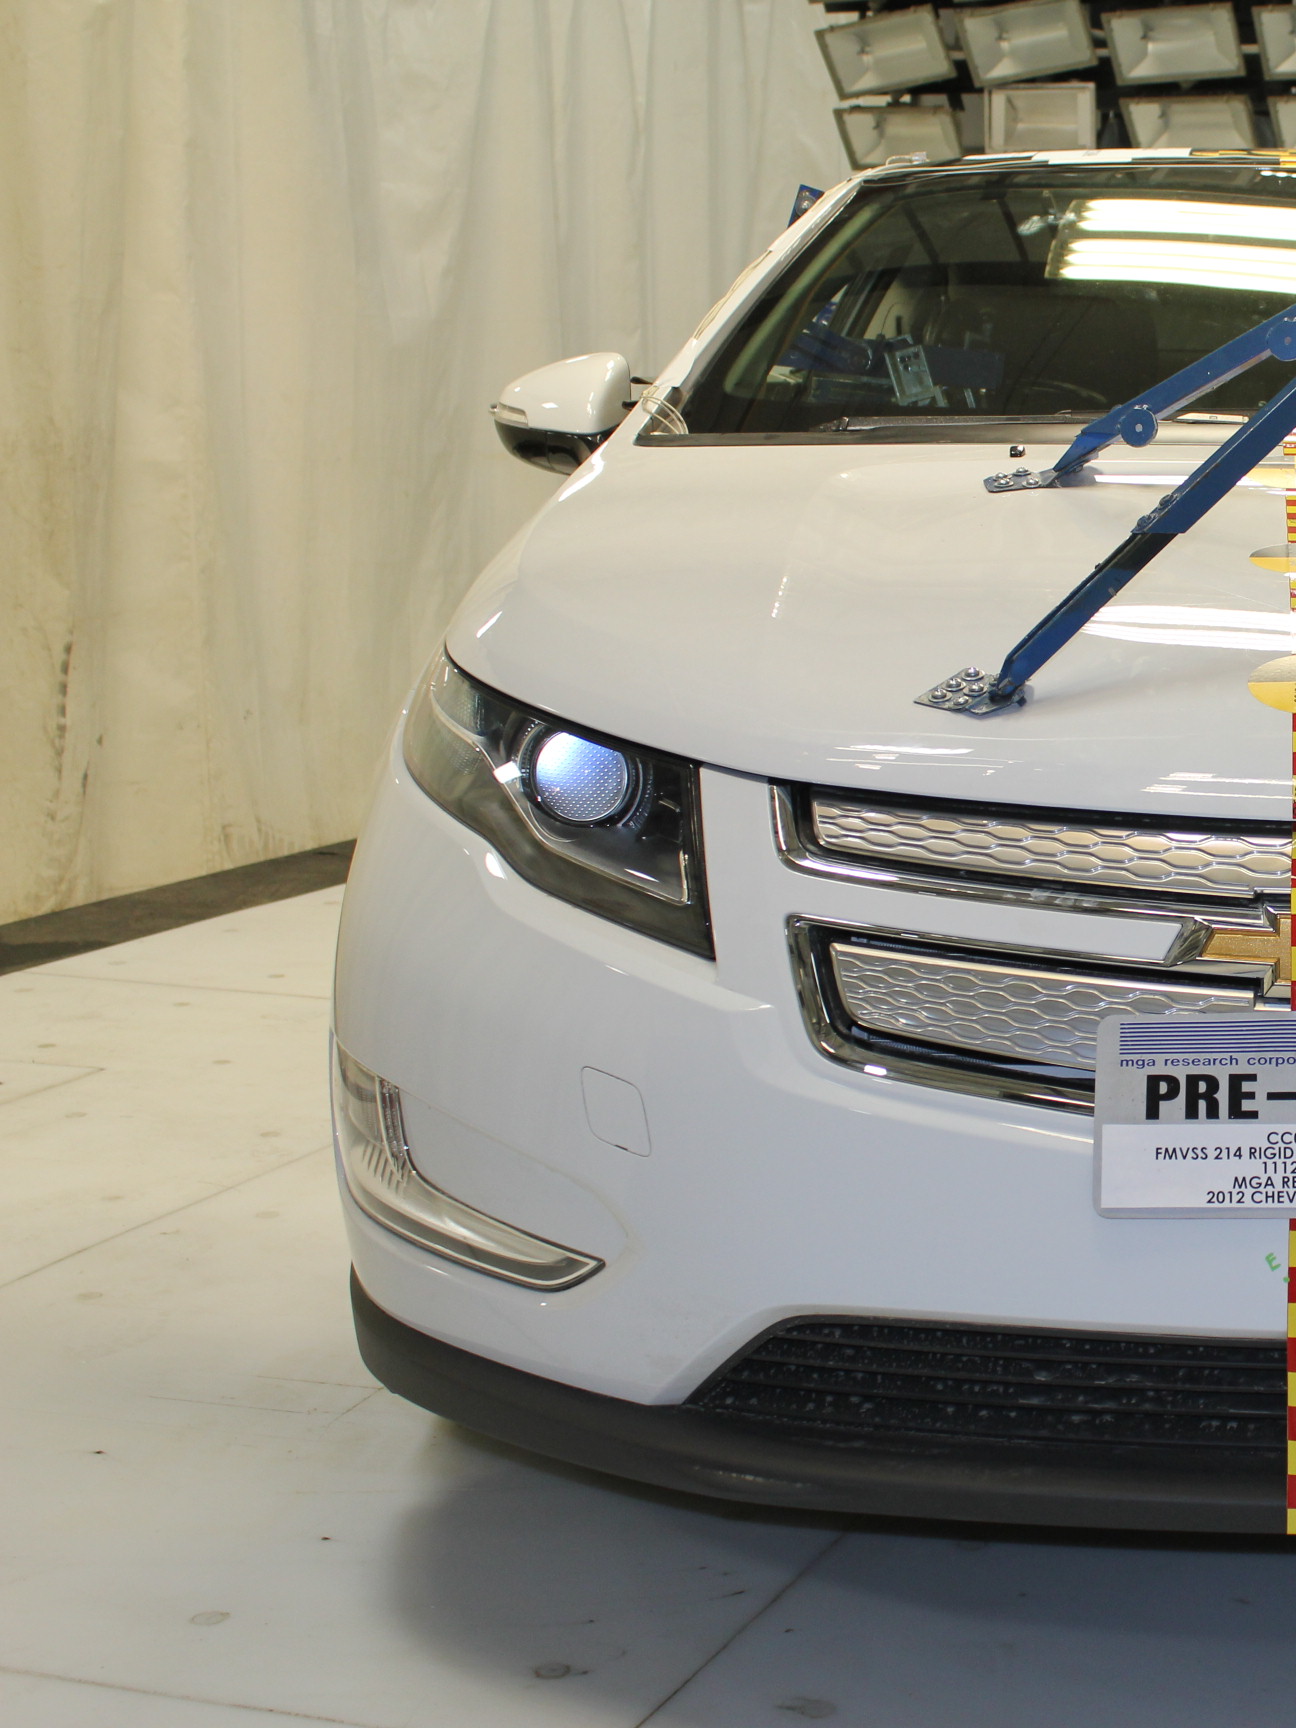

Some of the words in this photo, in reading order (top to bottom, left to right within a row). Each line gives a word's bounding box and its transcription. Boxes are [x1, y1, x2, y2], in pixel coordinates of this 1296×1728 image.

[1120, 1058, 1156, 1069] mga
[1164, 1054, 1239, 1066] research
[1155, 1147, 1209, 1161] FMVSS
[1213, 1147, 1243, 1160] 214
[1248, 1147, 1295, 1160] RIGID
[1232, 1176, 1276, 1190] MGA
[1206, 1190, 1246, 1205] 2012
